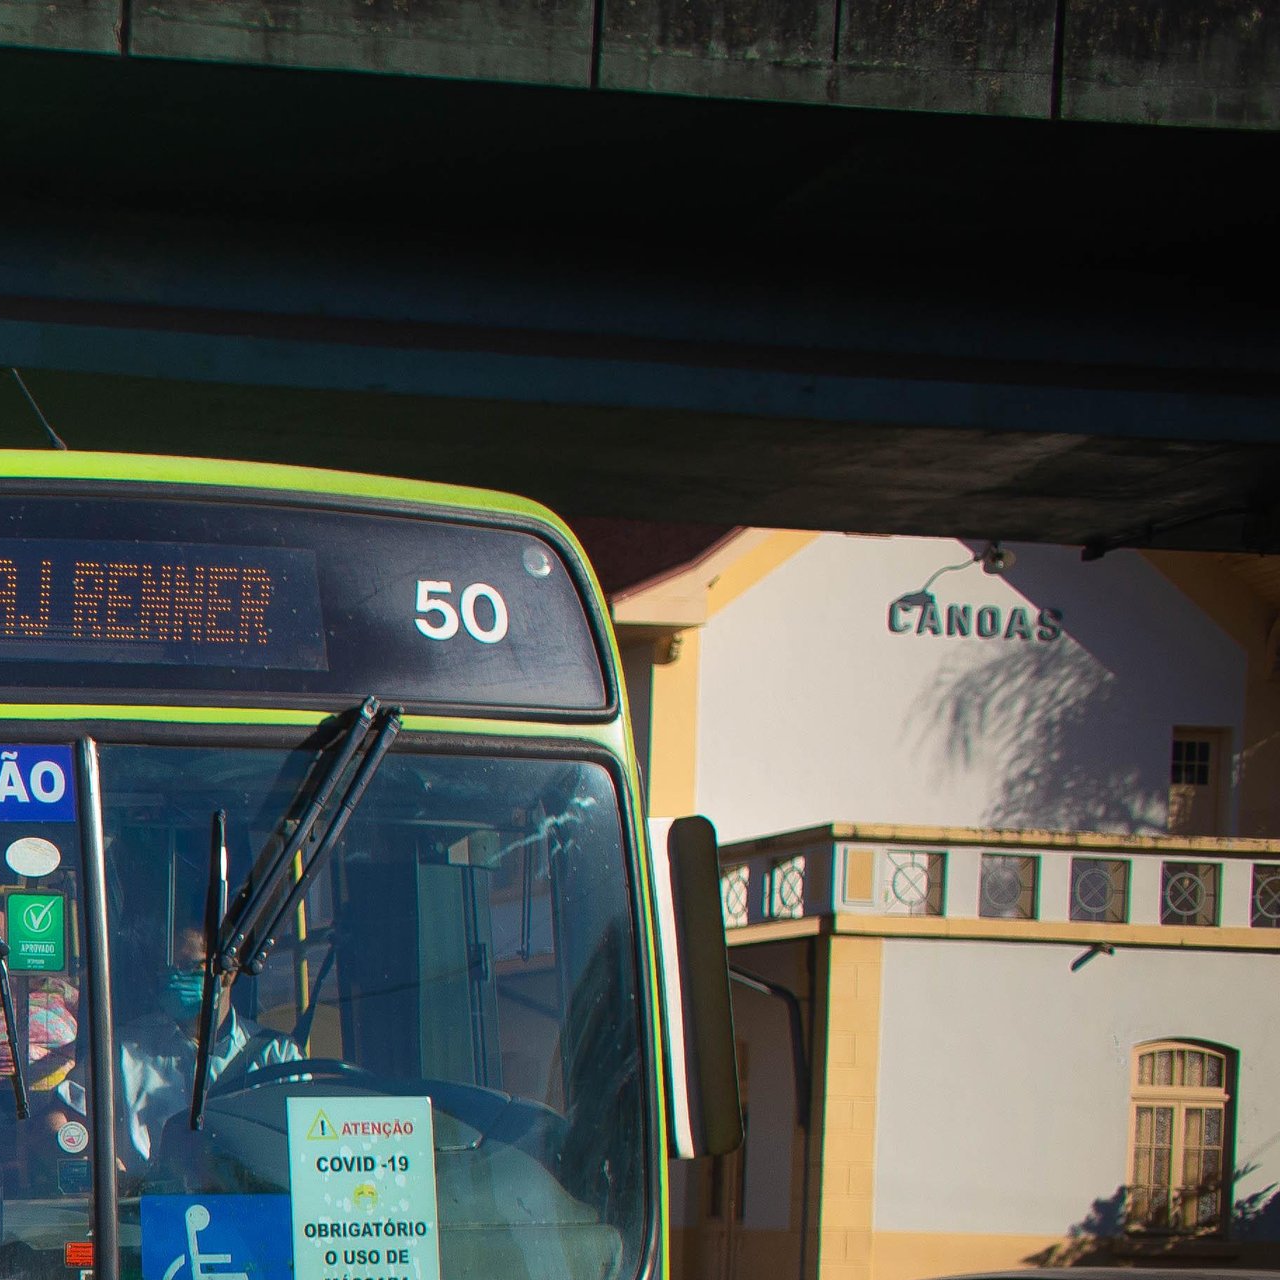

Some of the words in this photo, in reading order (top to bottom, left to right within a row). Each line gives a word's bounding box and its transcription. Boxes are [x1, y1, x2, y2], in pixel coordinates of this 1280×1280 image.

[73, 561, 273, 645] RENNER
[414, 579, 509, 644] 50
[887, 601, 1063, 642] CANOAS
[22, 943, 55, 954] APROVADO
[342, 1121, 414, 1138] ATENÇÃO
[316, 1155, 375, 1172] COVID
[381, 1155, 409, 1172] -19
[304, 1219, 427, 1238] OBRIGATÓRIO
[325, 1250, 337, 1265] O
[344, 1250, 381, 1265] USO
[386, 1249, 410, 1264] DE
